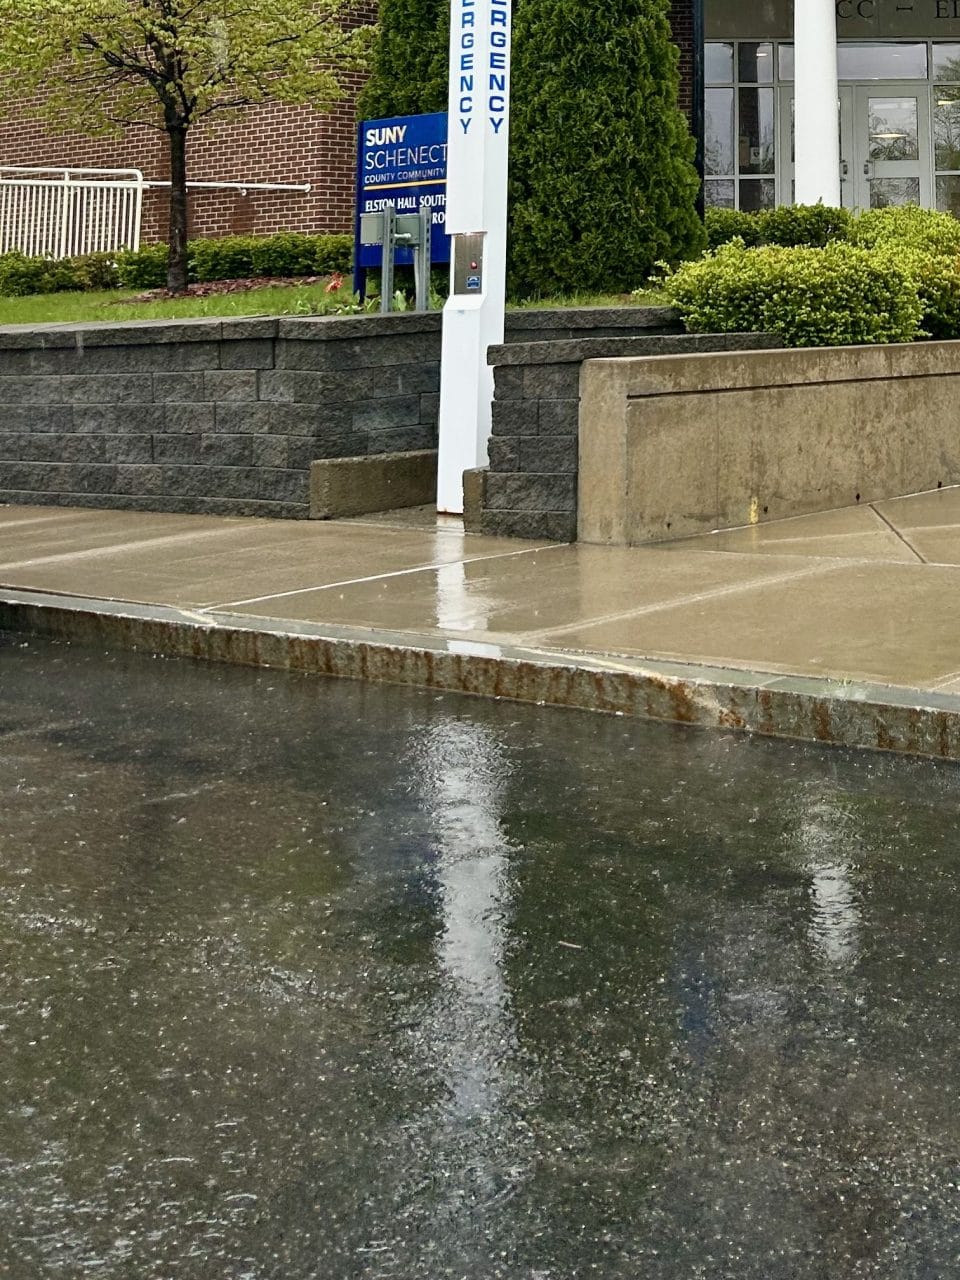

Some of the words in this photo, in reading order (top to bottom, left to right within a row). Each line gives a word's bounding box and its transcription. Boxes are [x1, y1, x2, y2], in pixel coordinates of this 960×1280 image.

[365, 125, 408, 147] SUNY
[364, 173, 395, 184] COUNTY
[397, 167, 446, 180] COMMUNITY
[365, 198, 396, 212] ELSTON
[397, 196, 418, 210] HALL
[432, 211, 448, 224] RO
